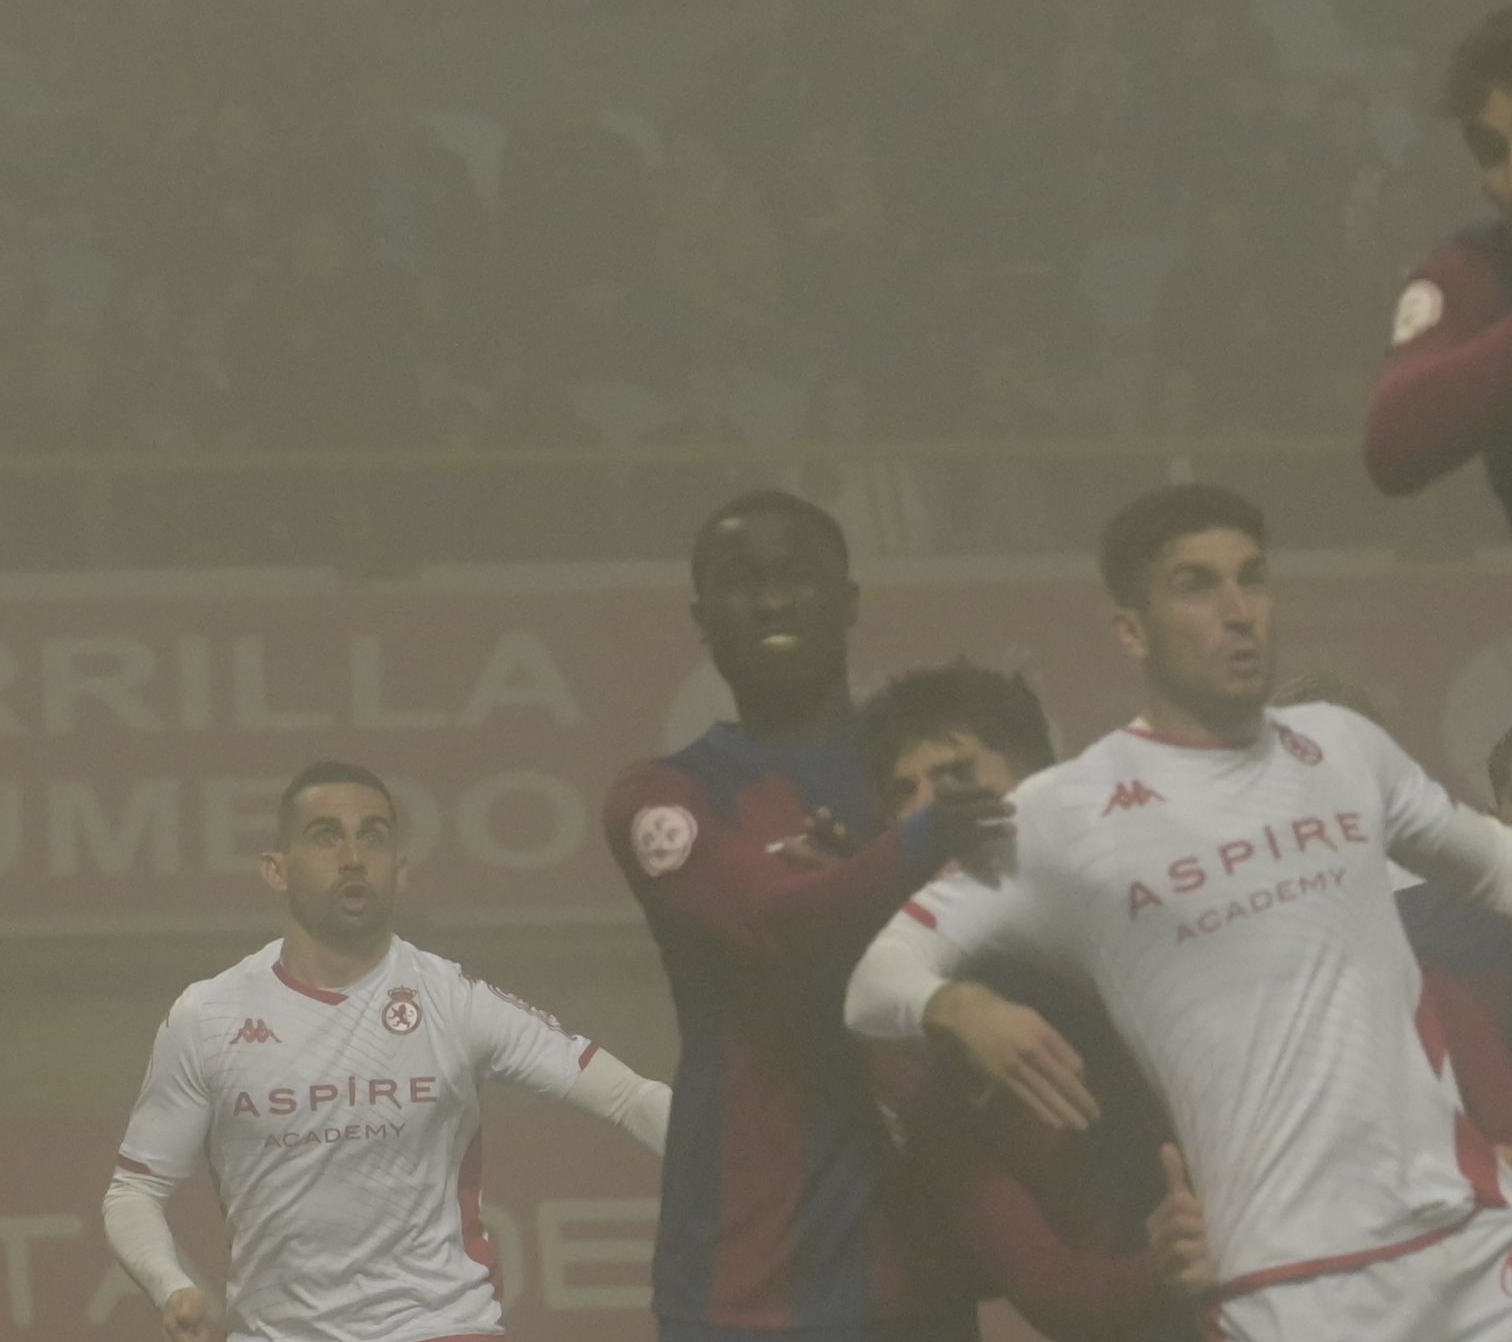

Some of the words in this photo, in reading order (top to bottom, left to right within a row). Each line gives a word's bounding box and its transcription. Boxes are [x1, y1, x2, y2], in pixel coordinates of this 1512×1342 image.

[1128, 809, 1370, 918] ASPIRE
[1176, 865, 1349, 945] ACADEMY
[232, 1075, 438, 1118] ASPIRE
[263, 1121, 406, 1150] ACADEMY
